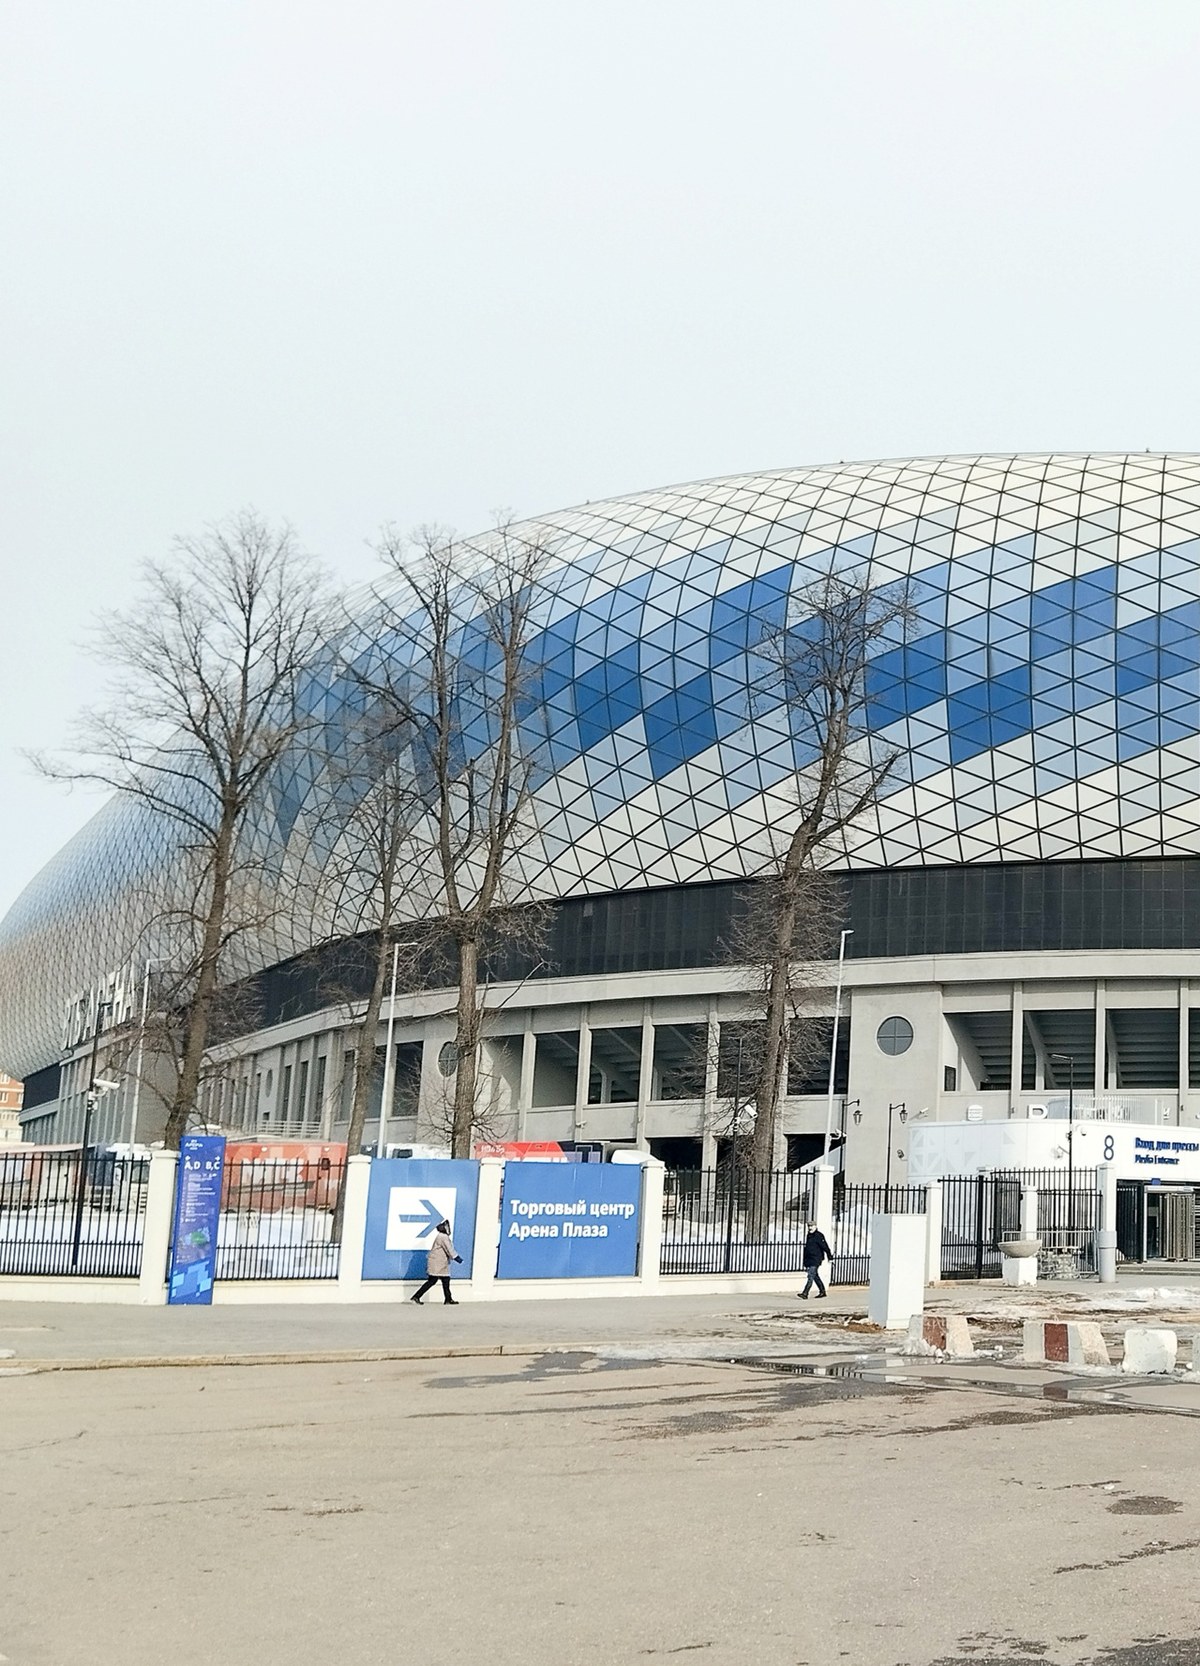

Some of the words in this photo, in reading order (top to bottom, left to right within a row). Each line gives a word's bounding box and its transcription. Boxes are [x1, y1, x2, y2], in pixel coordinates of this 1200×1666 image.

[1104, 1135, 1114, 1161] 8
[510, 1199, 586, 1219] Торговый
[590, 1202, 635, 1220] центр
[508, 1222, 559, 1240] Арена
[562, 1222, 608, 1238] Плаза
